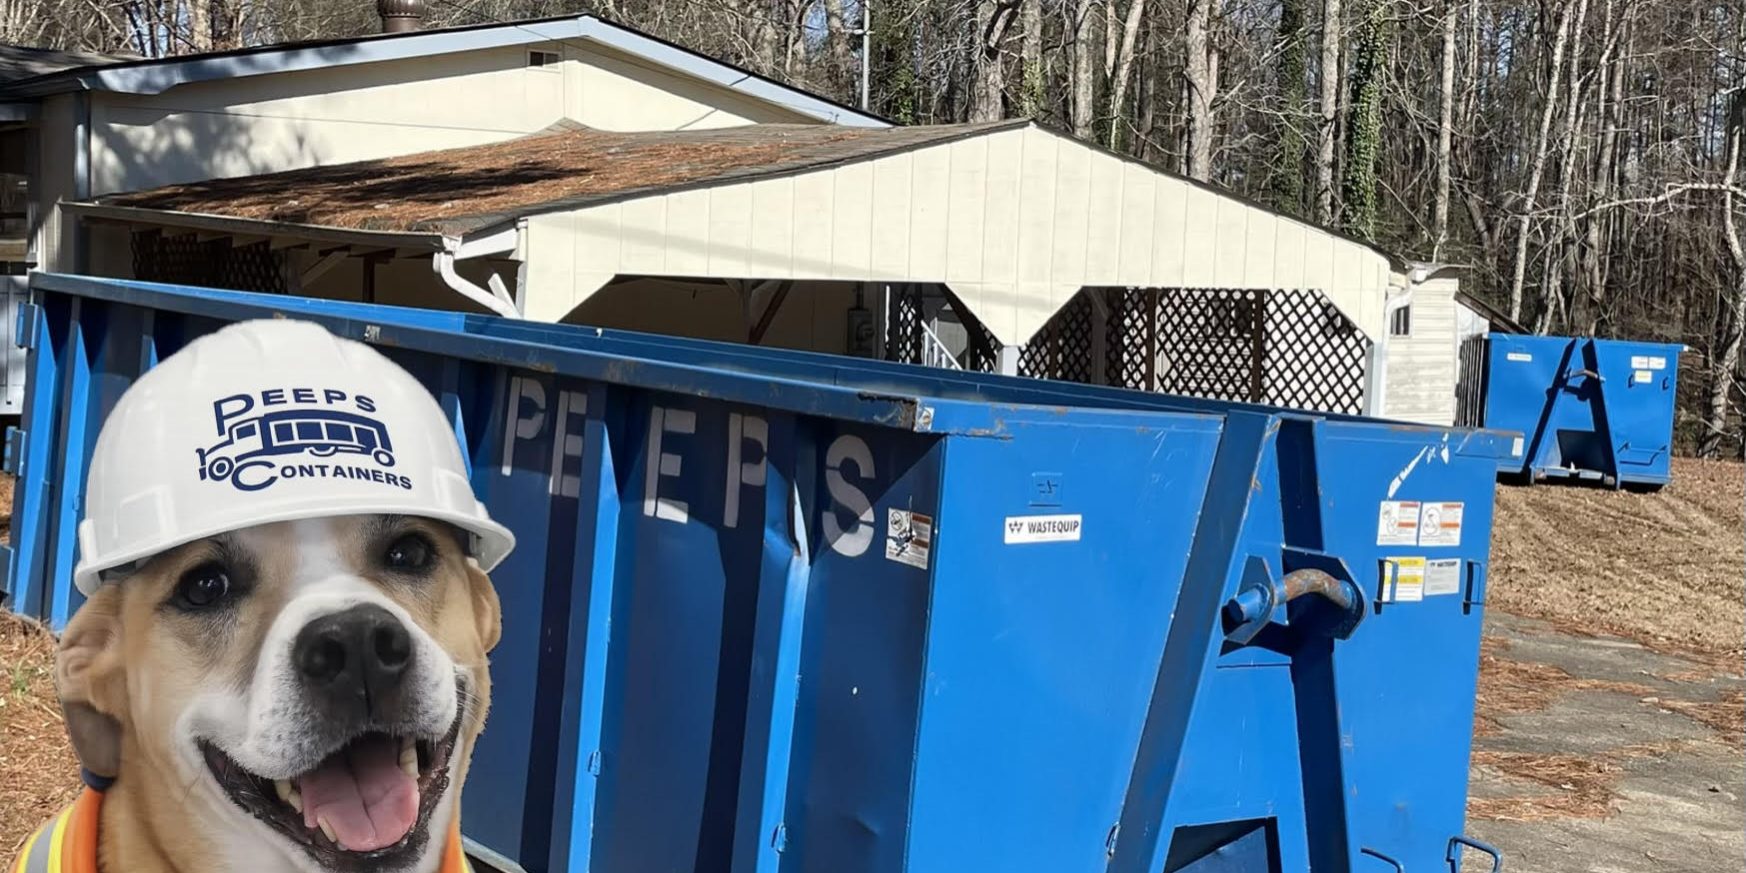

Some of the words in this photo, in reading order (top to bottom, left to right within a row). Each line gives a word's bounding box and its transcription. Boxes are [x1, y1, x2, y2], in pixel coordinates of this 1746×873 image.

[213, 388, 377, 437] PEEPS
[231, 460, 413, 492] CONTAINERS
[1028, 520, 1079, 534] WASTEQUIP
